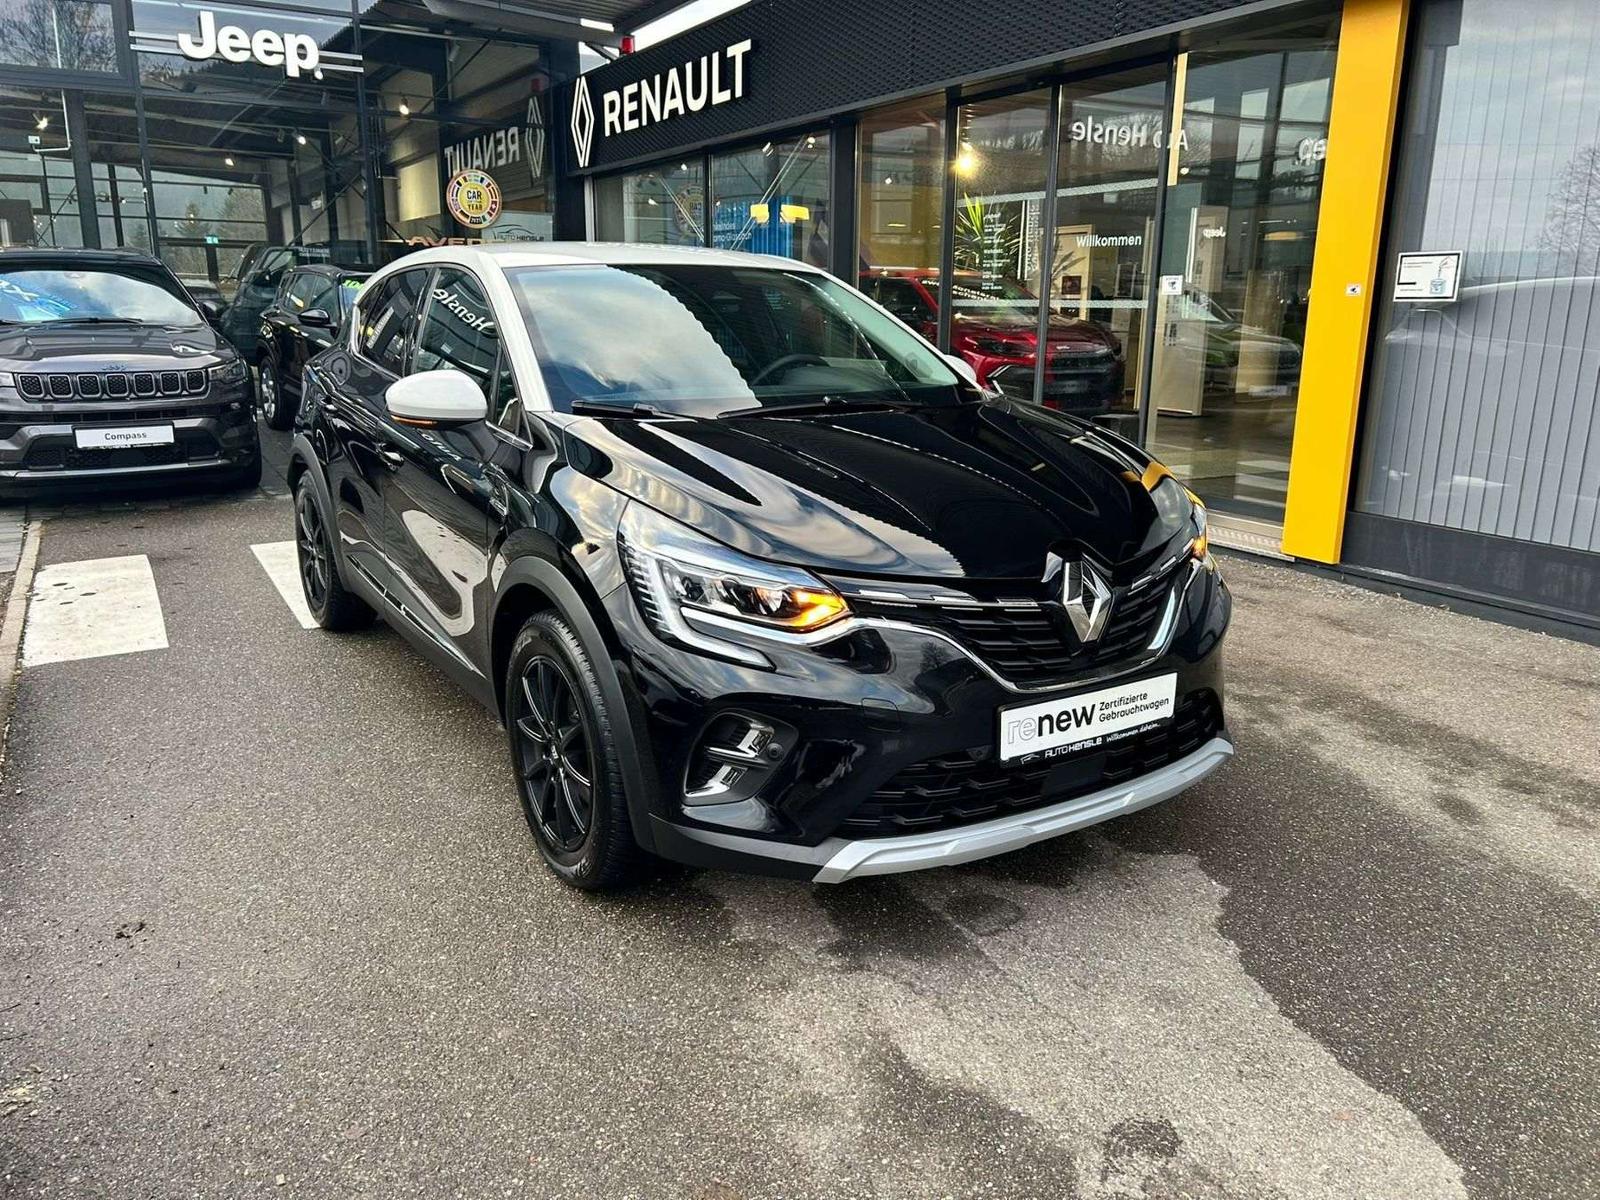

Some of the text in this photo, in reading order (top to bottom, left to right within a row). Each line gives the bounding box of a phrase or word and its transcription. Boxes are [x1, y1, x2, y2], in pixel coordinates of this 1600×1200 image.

[178, 10, 324, 80] Jeep
[603, 38, 752, 138] RENAULT
[466, 190, 482, 200] CAR
[1076, 234, 1142, 247] Willkommen
[104, 432, 147, 441] Compass
[1098, 697, 1170, 723] Gebrauchtwagen
[1099, 691, 1148, 711] Zertifizierte
[1007, 704, 1096, 744] renew
